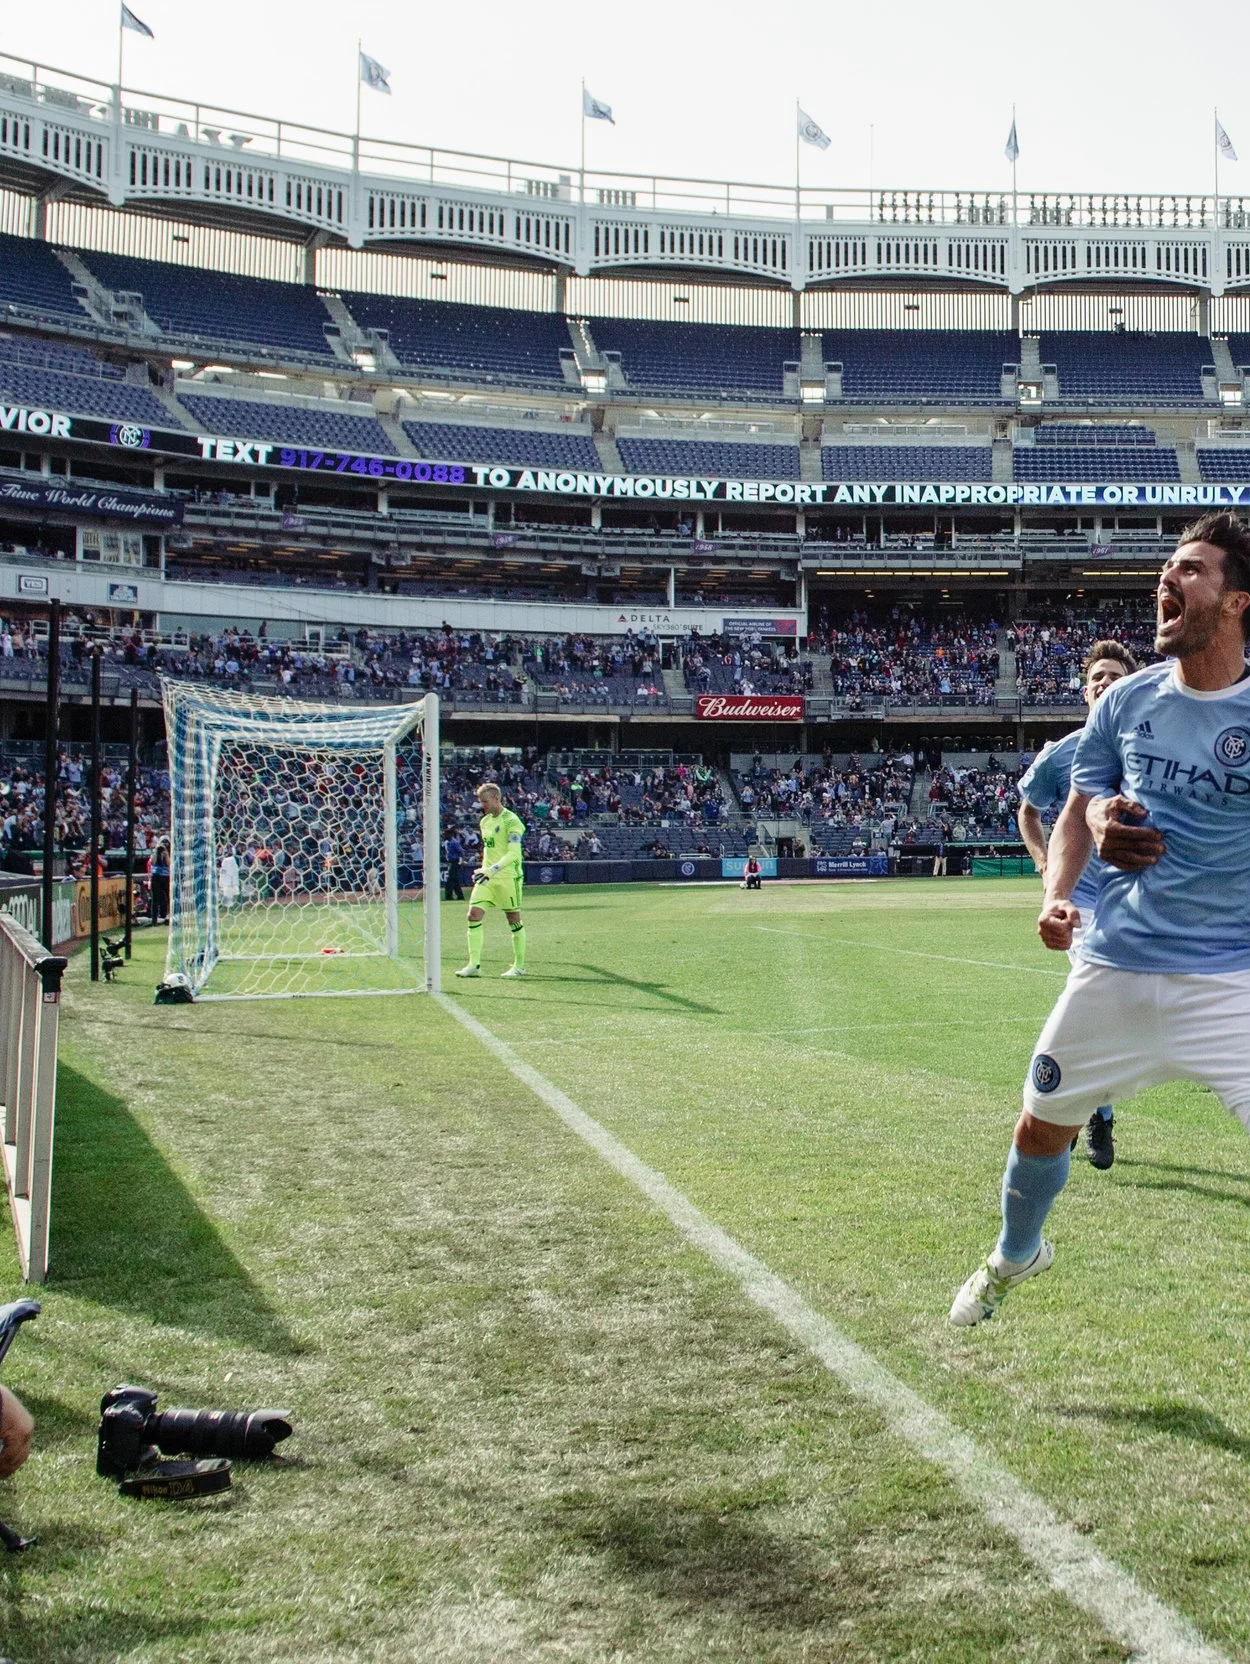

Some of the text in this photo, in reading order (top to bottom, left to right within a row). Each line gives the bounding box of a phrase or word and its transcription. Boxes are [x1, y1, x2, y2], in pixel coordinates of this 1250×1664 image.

[197, 437, 273, 464] TEXT
[280, 448, 465, 484] 917-746-0088
[472, 466, 511, 488] TO
[516, 470, 720, 500] ANONYMOUSLY
[726, 481, 827, 503] REPORT
[834, 484, 889, 503] ANY
[895, 484, 1096, 504] INAPPROPRIATE
[1102, 486, 1139, 505] OR
[1145, 486, 1245, 505] UNRULY
[45, 489, 93, 507] World
[98, 495, 175, 518] Champions
[630, 614, 671, 623] DELTA
[699, 697, 801, 719] Budweiser
[1147, 780, 1229, 806] IRWAYS
[849, 861, 867, 869] Lynch
